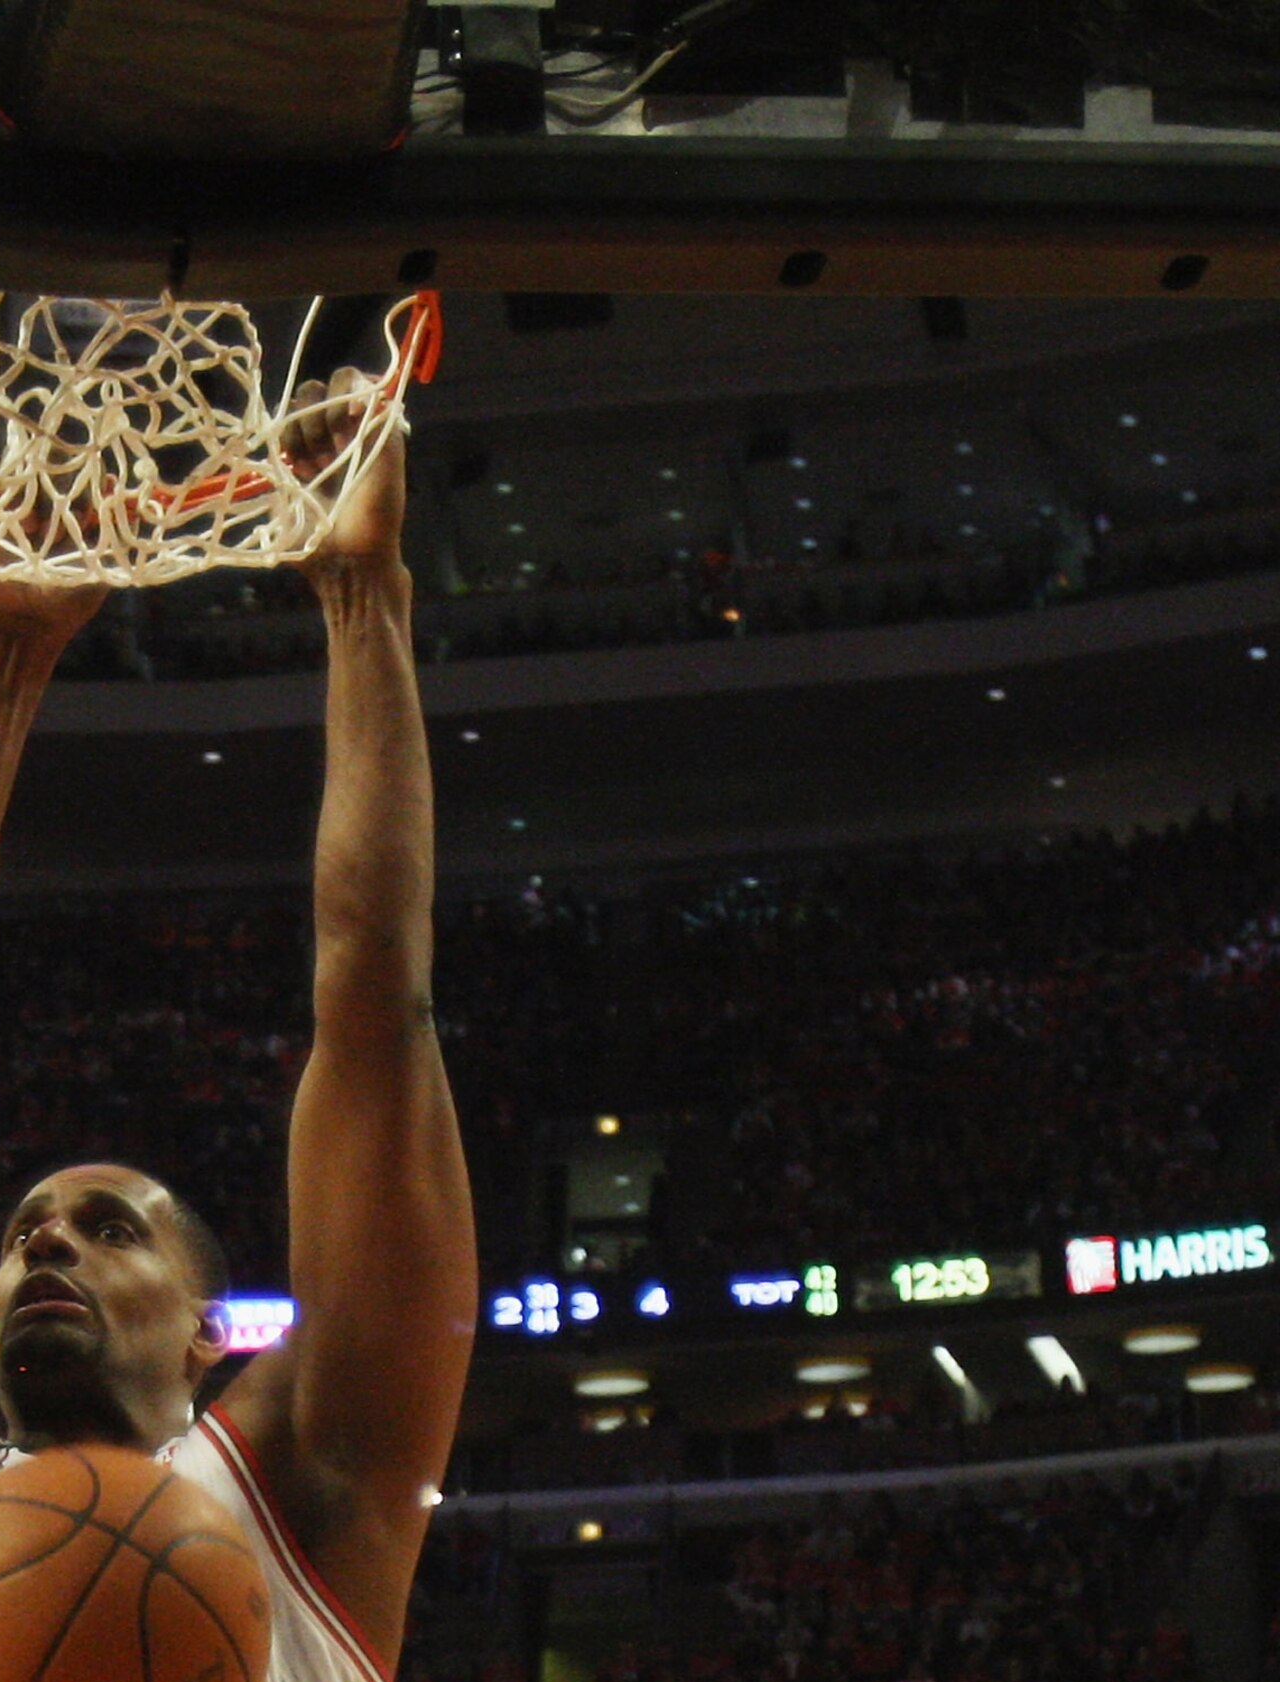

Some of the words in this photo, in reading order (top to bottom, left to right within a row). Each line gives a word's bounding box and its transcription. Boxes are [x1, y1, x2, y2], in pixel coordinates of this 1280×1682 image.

[1120, 1225, 1270, 1284] HARRIS
[731, 1280, 801, 1306] TOT
[891, 1257, 991, 1302] 12:53
[493, 1296, 523, 1326] 2
[639, 1287, 670, 1317] 4
